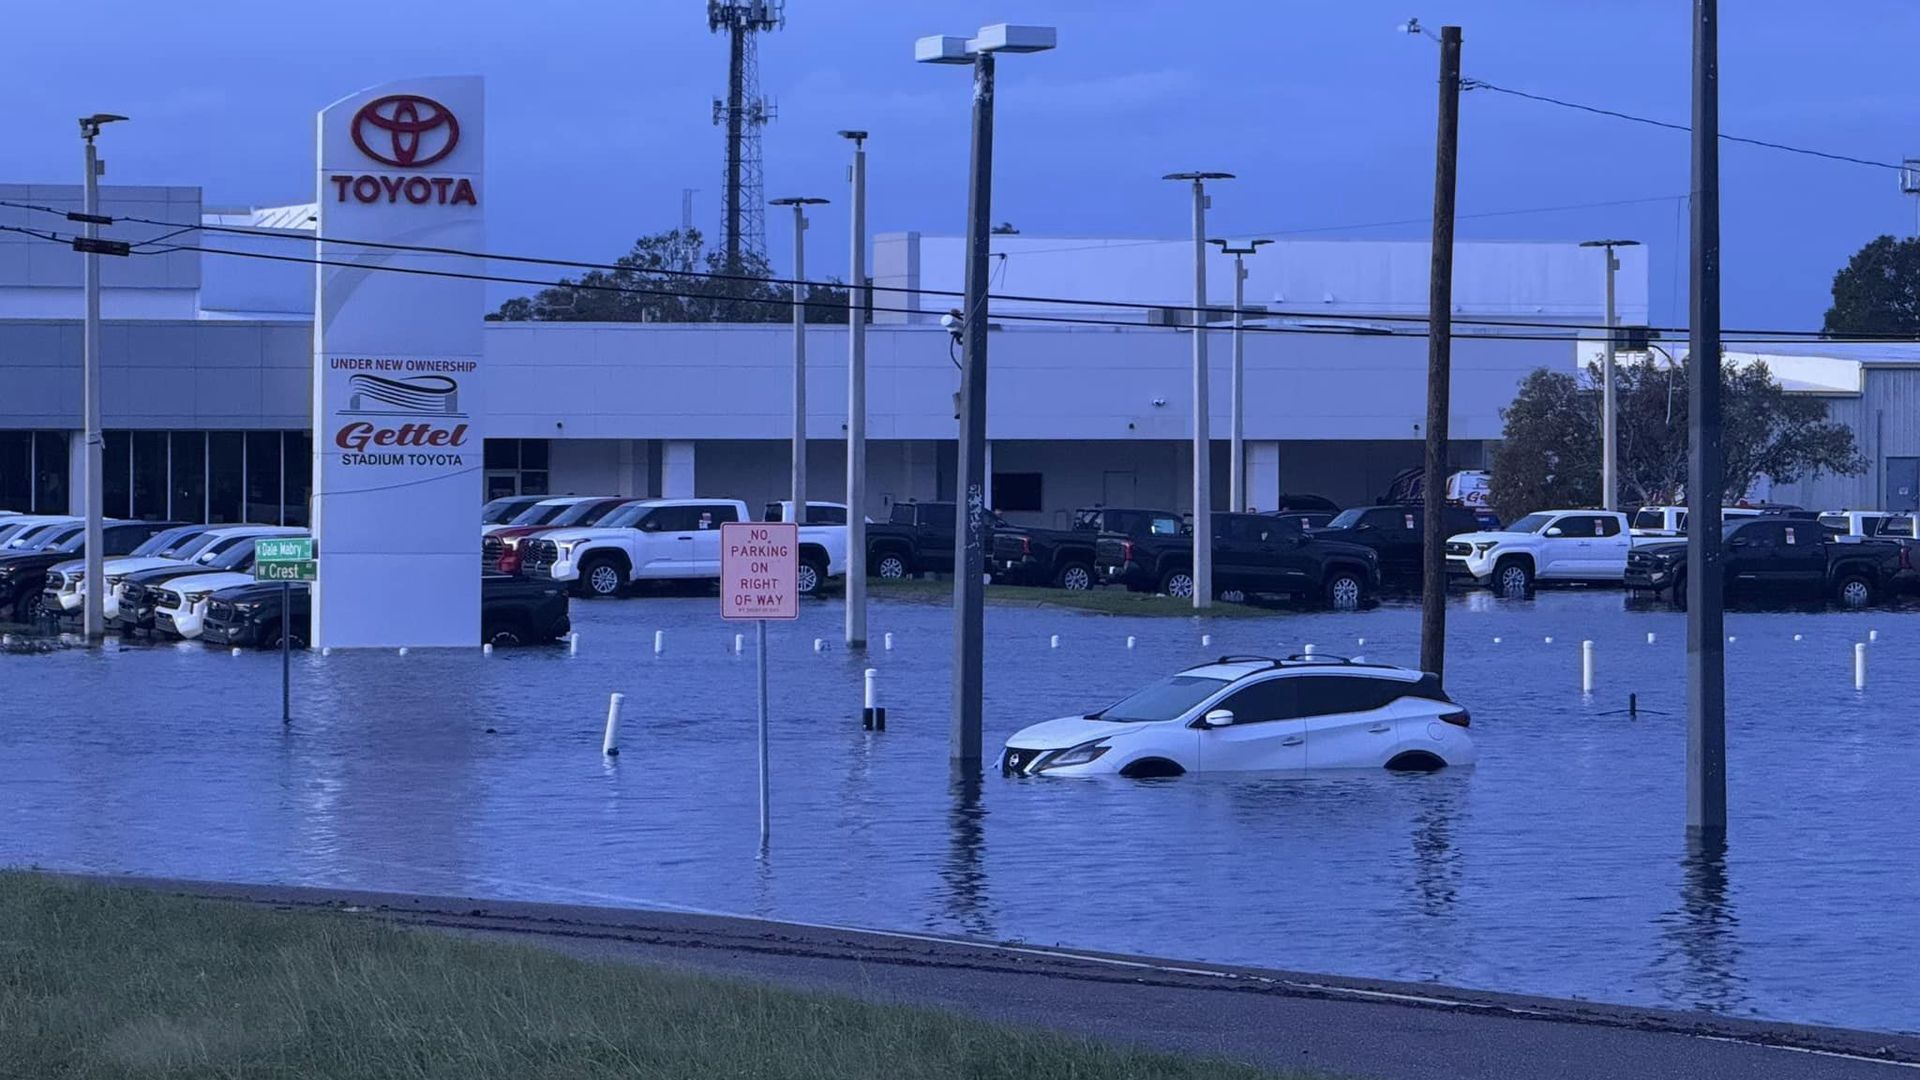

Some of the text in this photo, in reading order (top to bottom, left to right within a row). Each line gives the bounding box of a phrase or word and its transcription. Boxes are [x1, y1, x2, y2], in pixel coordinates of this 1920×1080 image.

[331, 175, 477, 206] TOYOTA
[331, 358, 477, 372] UNDER NEW OWNERSHIP
[335, 422, 468, 452] Gettel
[342, 454, 463, 466] STADIUM TOYOTA
[751, 529, 768, 541] NO
[262, 542, 278, 556] Dale
[280, 542, 301, 558] Mabry
[731, 545, 788, 557] PARKING
[269, 563, 299, 579] Crest
[751, 562, 768, 573] ON
[741, 579, 779, 590] RIGHT
[735, 594, 784, 606] OF WAY
